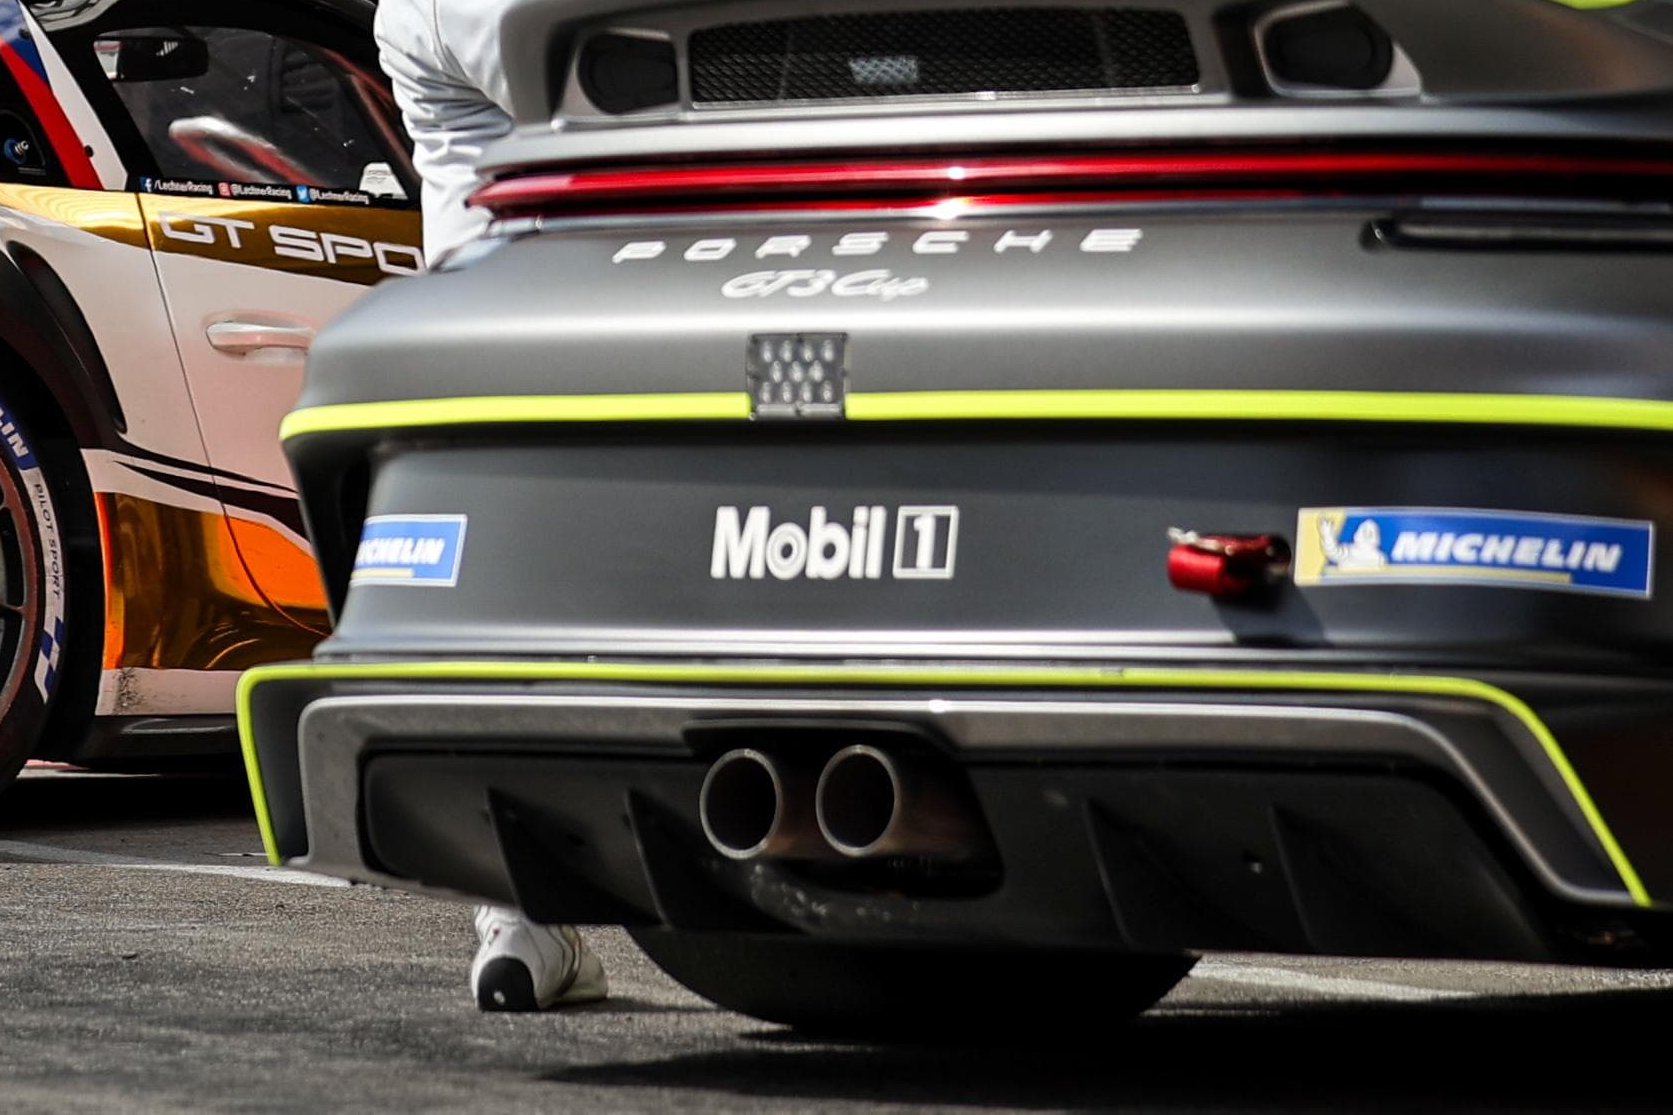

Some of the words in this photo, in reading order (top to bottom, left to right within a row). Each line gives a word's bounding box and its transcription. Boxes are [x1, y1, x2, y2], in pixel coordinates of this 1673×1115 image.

[157, 211, 255, 249] GT
[612, 228, 1143, 264] PORSCHE
[33, 483, 55, 533] PILOT
[48, 537, 62, 599] SPORT
[710, 505, 888, 581] Mobil
[1390, 530, 1623, 574] MICHELIN
